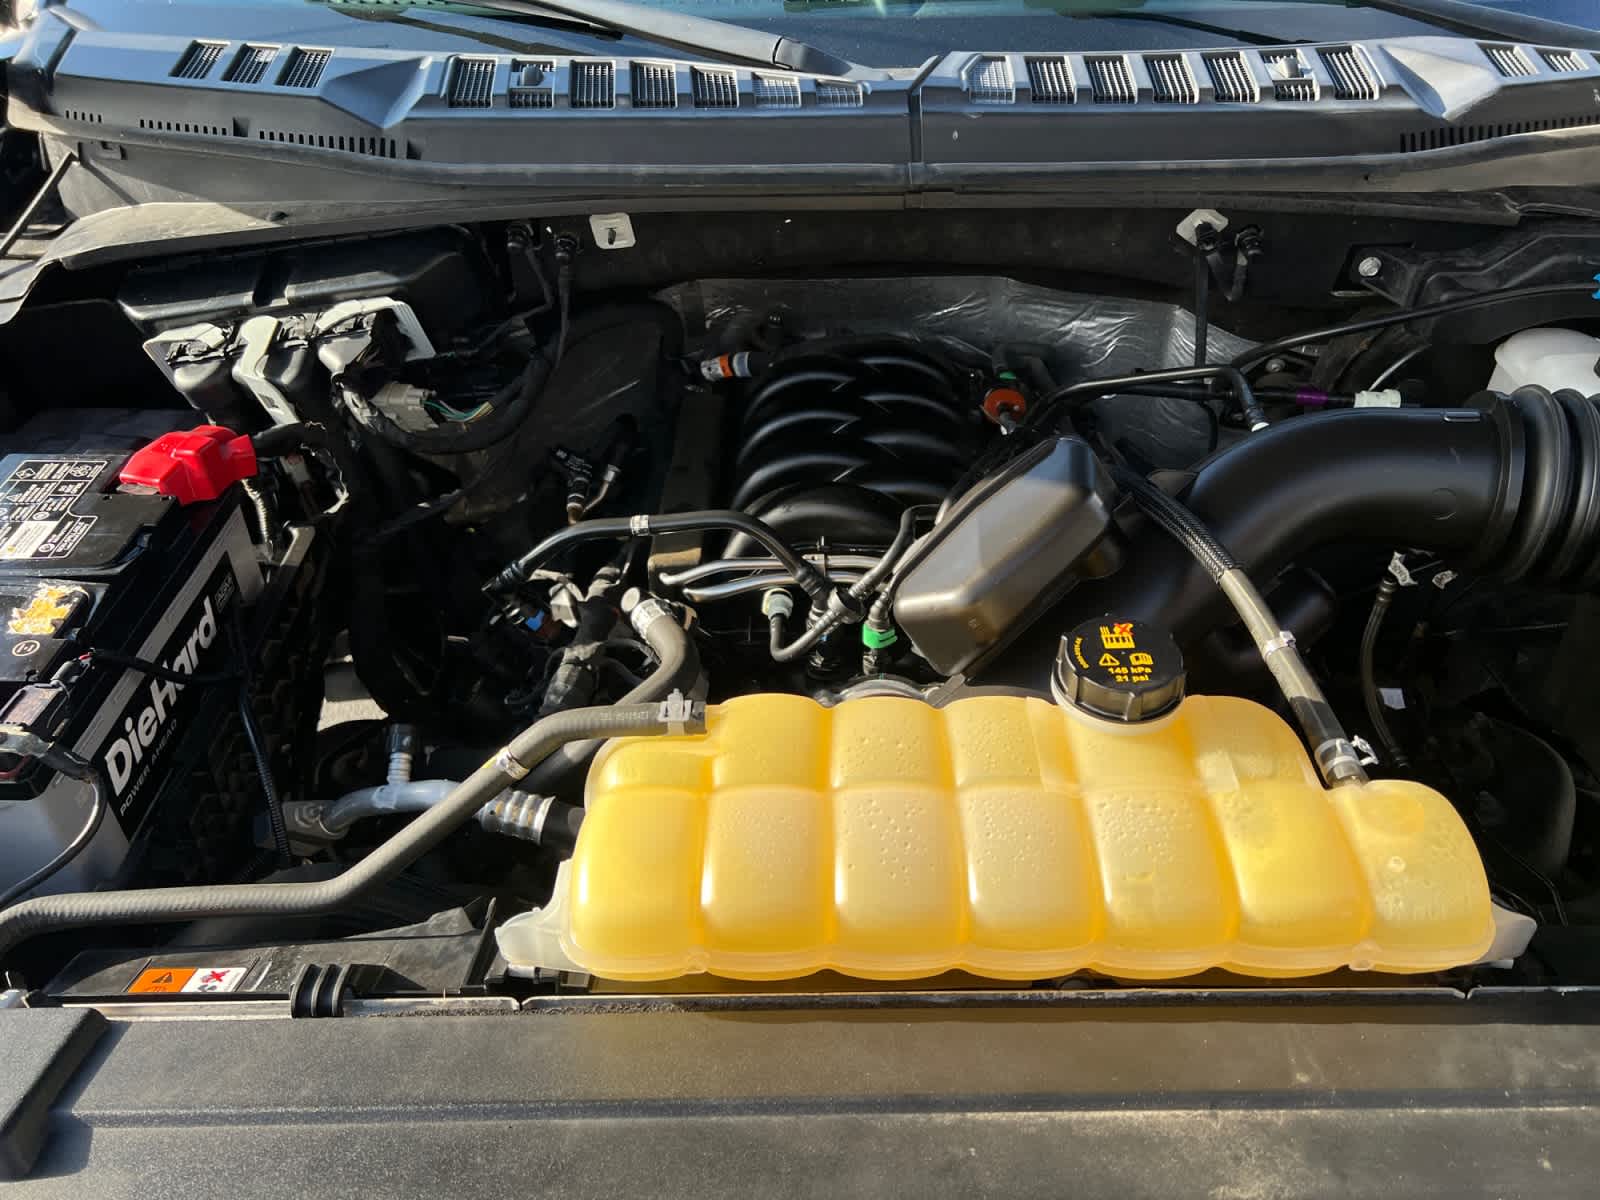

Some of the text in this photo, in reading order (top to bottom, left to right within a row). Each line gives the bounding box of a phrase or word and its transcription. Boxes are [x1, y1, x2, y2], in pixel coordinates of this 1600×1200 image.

[105, 596, 217, 796] DieHard
[120, 717, 178, 816] POWER AHEAD
